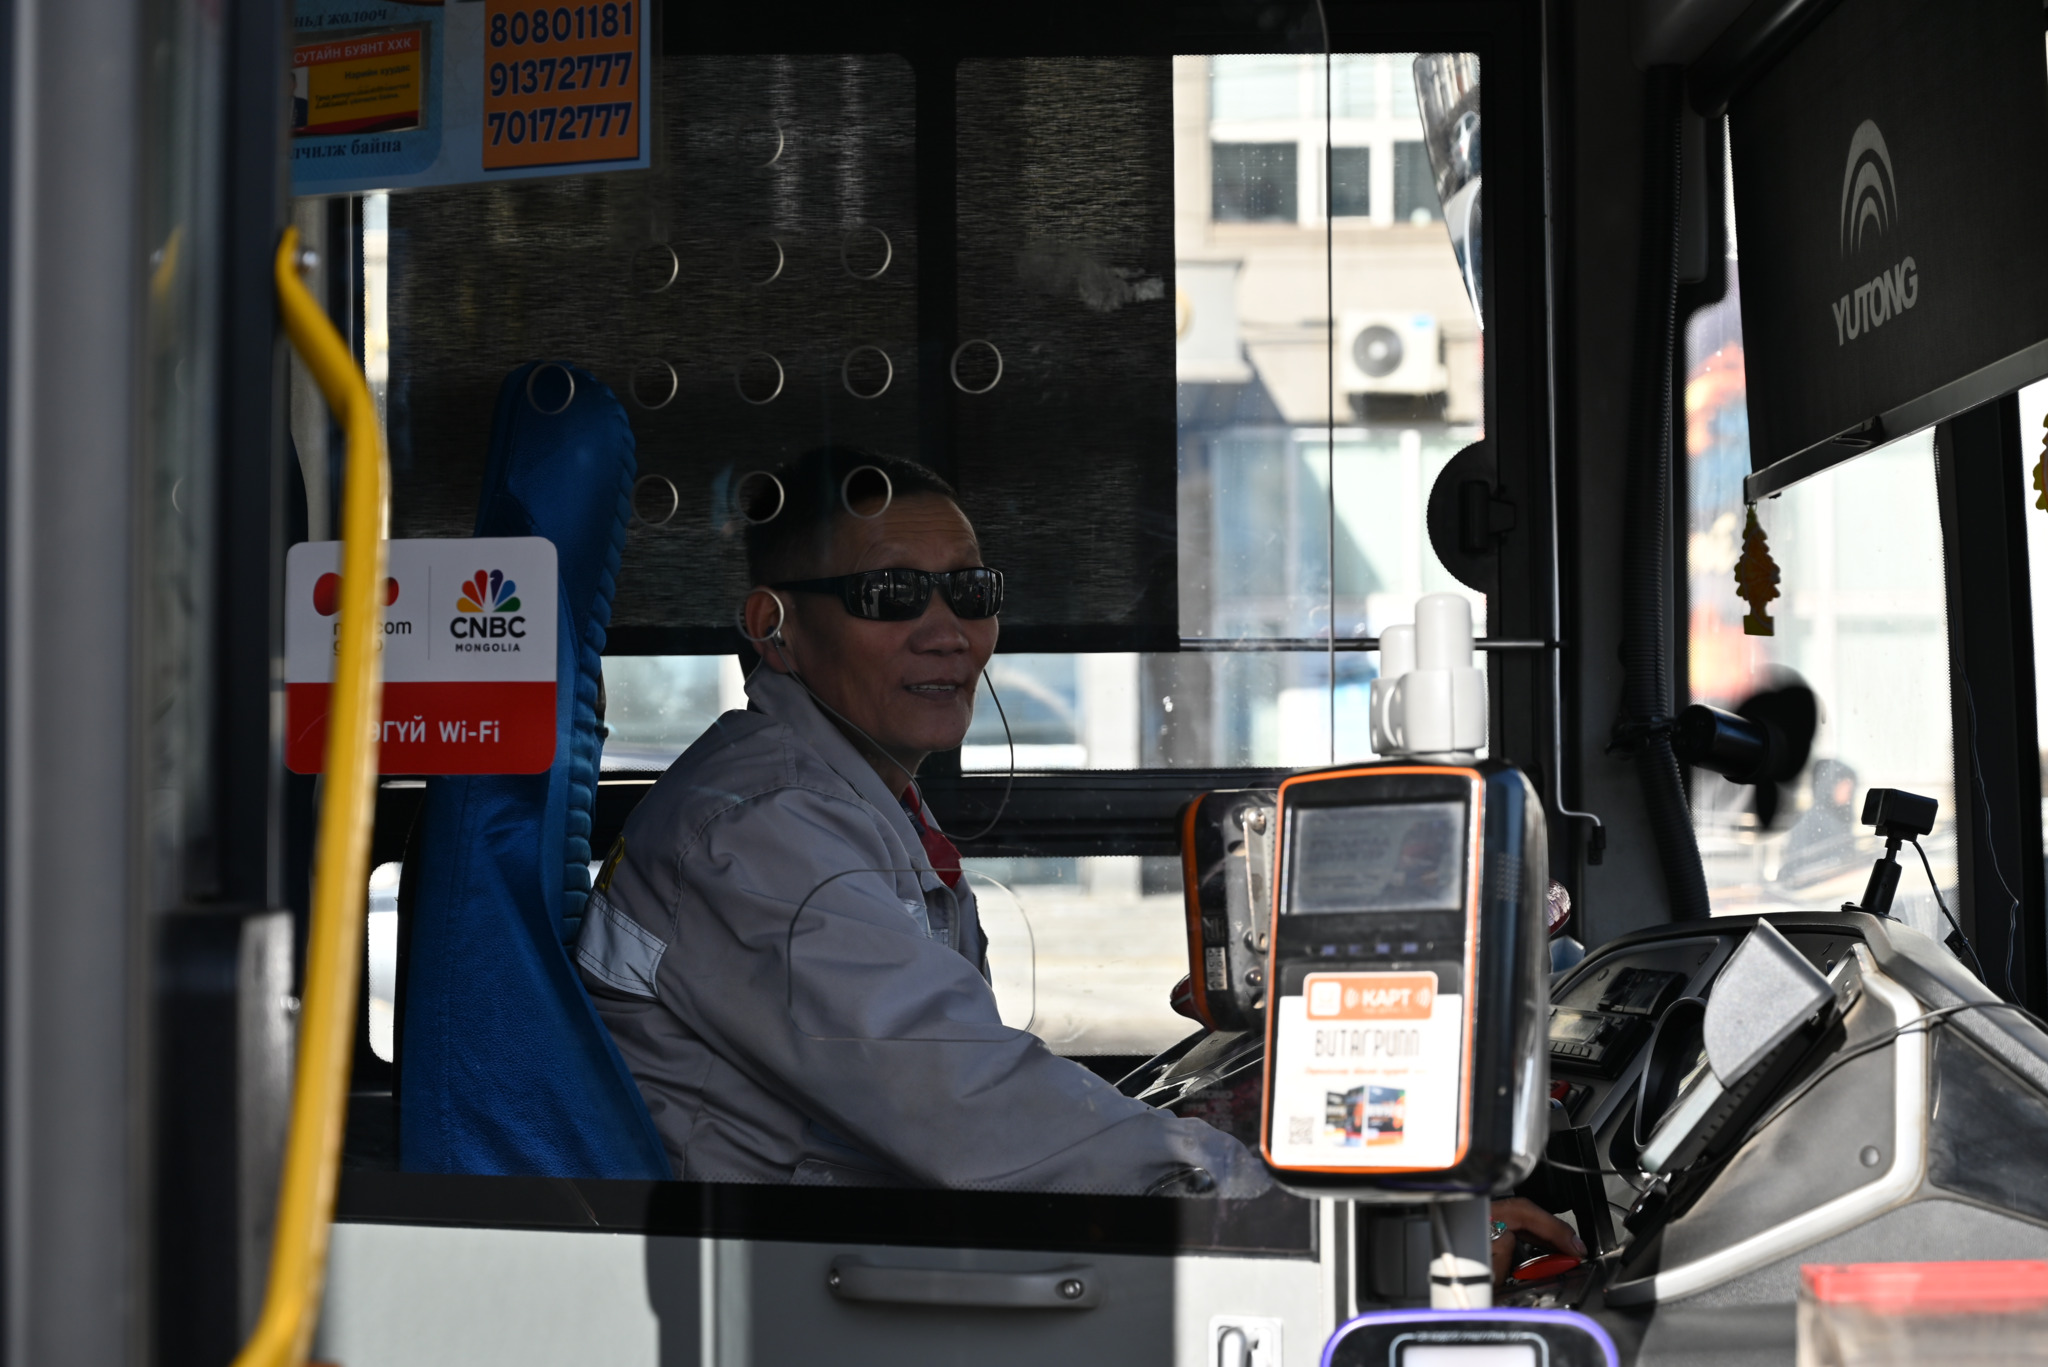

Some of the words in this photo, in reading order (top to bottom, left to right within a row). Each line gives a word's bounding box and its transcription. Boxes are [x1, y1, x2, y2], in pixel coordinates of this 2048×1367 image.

[328, 8, 388, 26] жолооч
[489, 1, 633, 47] 80801181
[293, 45, 341, 64] СУТАЙН
[344, 41, 384, 57] БУЯНТ
[388, 37, 413, 51] ХХК
[489, 51, 633, 97] 91372777
[487, 102, 633, 147] 70172777
[290, 143, 347, 160] лчилж
[351, 138, 402, 156] байна
[1832, 256, 1918, 346] YUTONG
[450, 616, 526, 638] CNBC
[455, 643, 521, 652] MONGOLIA
[438, 721, 500, 743] Wi-Fi
[1362, 988, 1412, 1007] КАРТ
